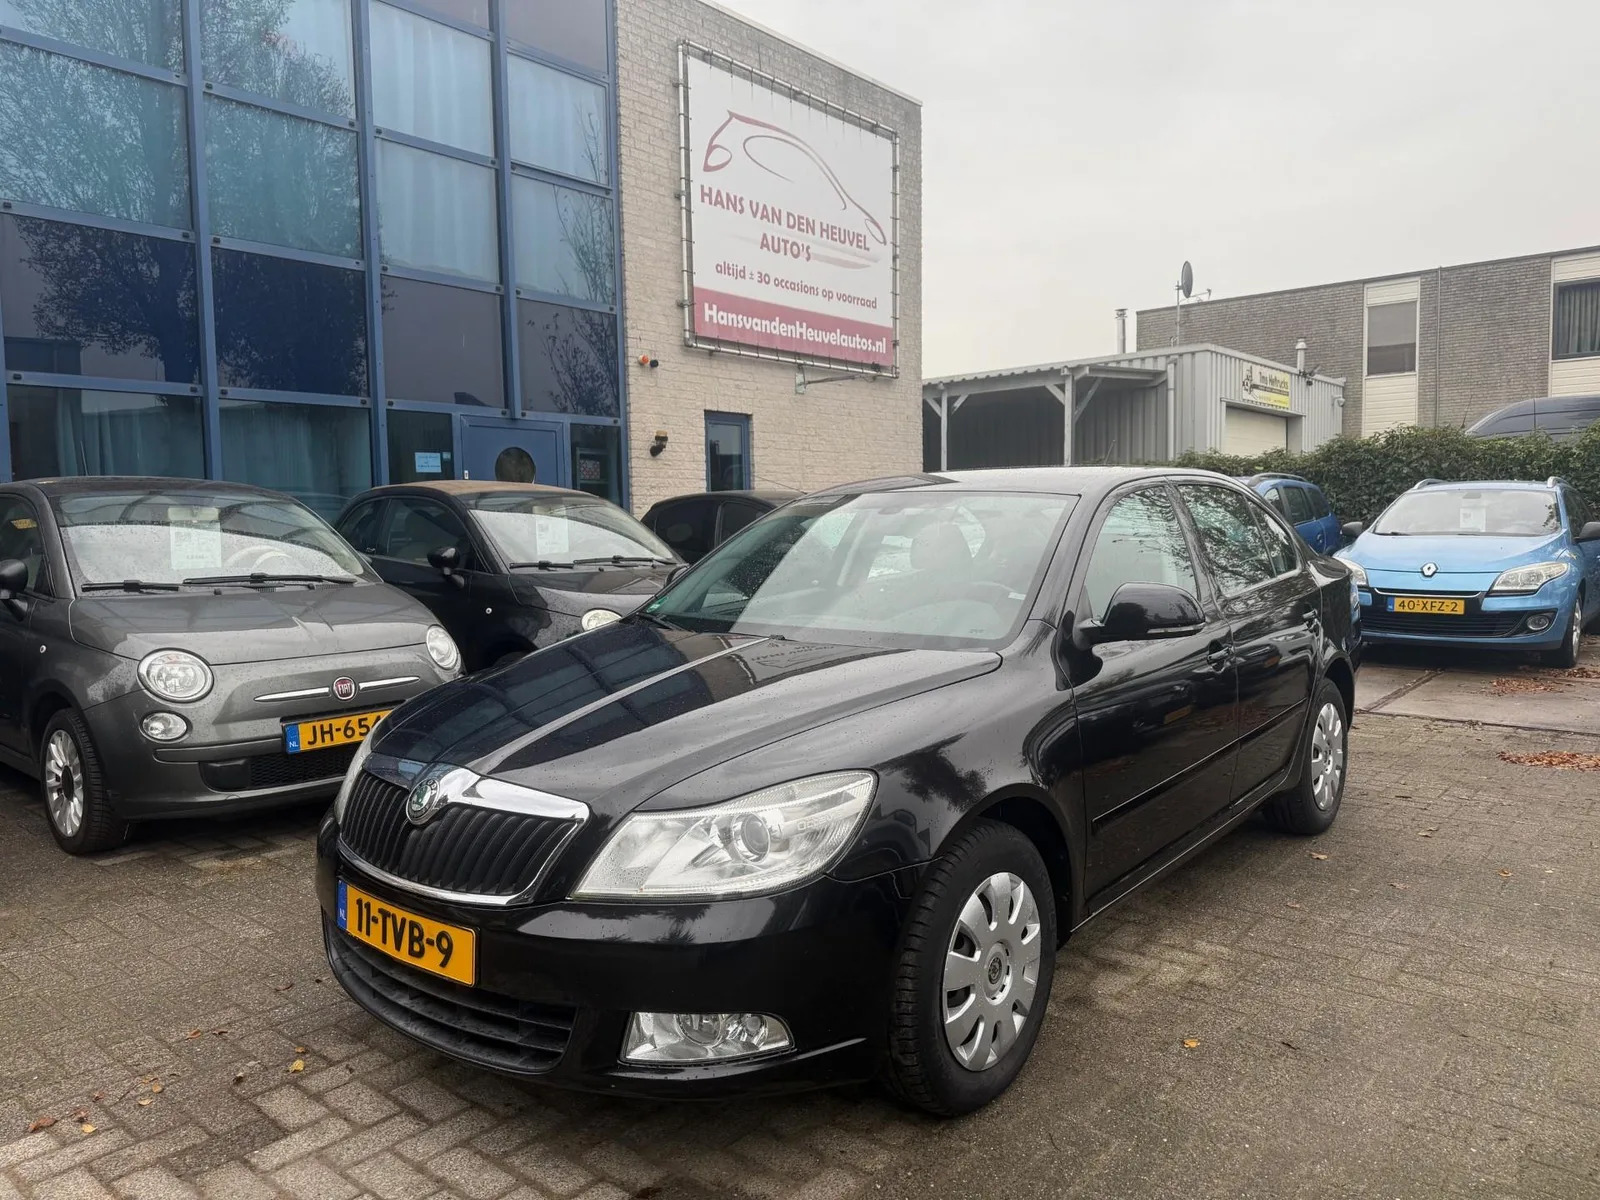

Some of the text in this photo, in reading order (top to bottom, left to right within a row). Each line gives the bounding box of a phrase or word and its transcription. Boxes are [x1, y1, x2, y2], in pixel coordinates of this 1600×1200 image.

[700, 184, 870, 251] HANS VAN DEN HEUVEL
[760, 233, 811, 262] AUTO'S
[715, 261, 746, 280] altijd
[757, 271, 770, 285] 30
[774, 277, 819, 297] occasions
[822, 288, 834, 301] op
[836, 292, 877, 309] voorraad
[704, 302, 886, 354] HansvandenHeuvelautos.nl
[1398, 599, 1458, 612] 40-XFZ-2
[337, 682, 351, 695] FIAT
[289, 740, 299, 748] NL
[339, 907, 347, 921] NL
[356, 897, 454, 968] 11-TVB-9
